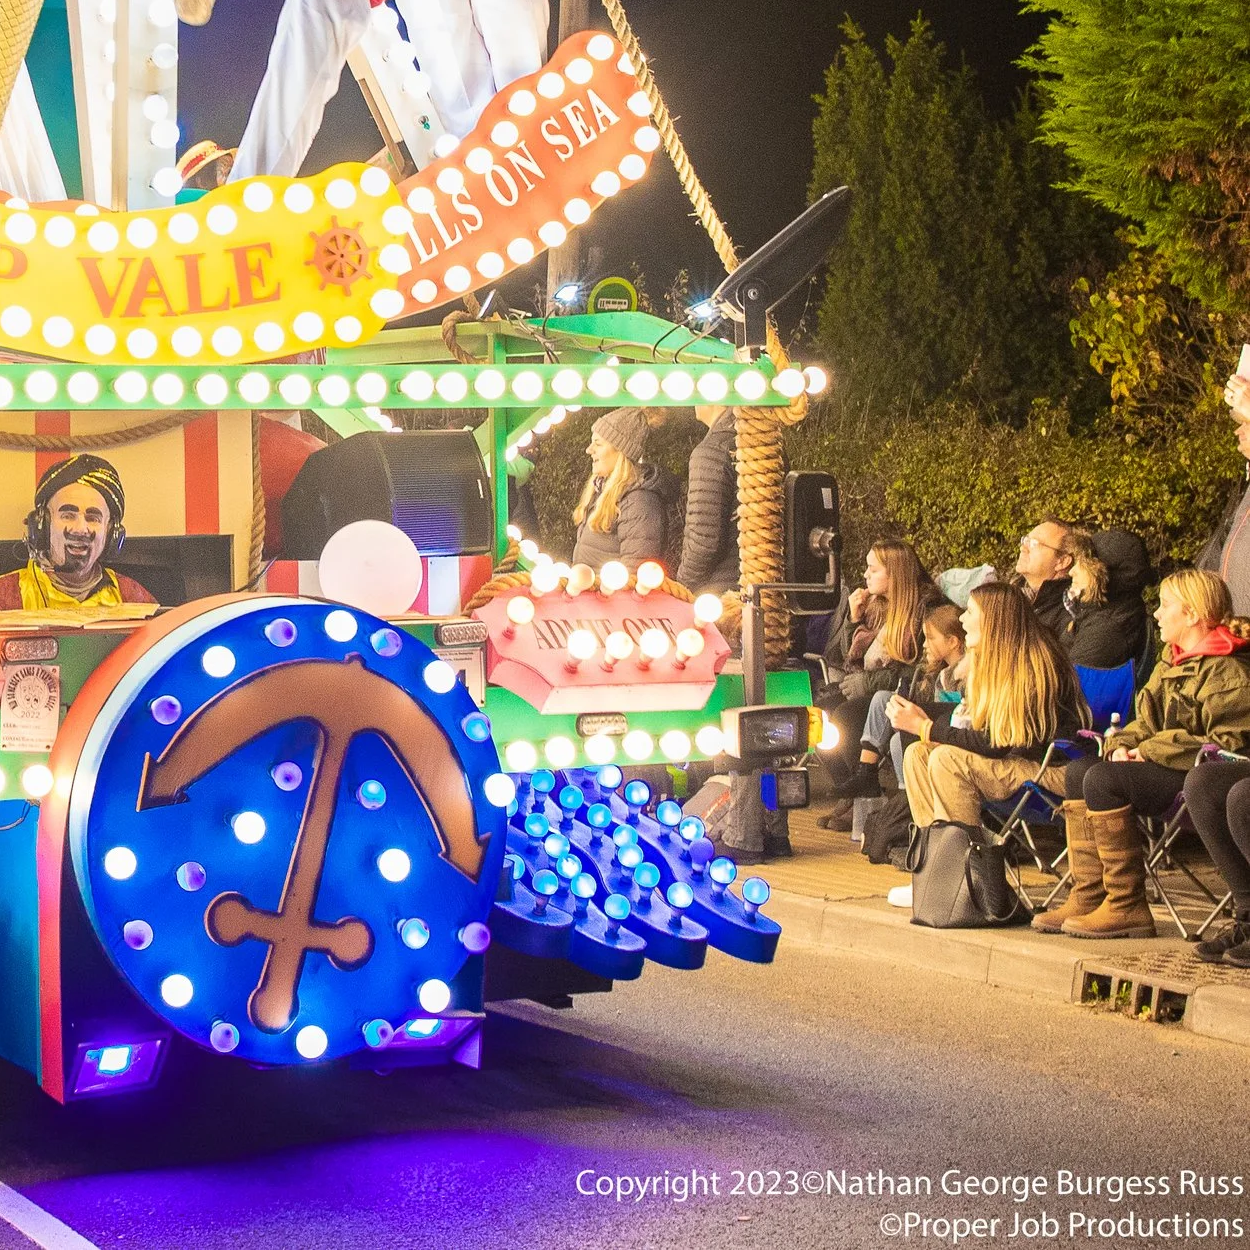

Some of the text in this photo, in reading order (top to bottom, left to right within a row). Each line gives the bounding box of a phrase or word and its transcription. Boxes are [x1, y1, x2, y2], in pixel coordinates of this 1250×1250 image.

[483, 139, 547, 208] ON
[539, 87, 622, 163] SEA
[77, 240, 282, 320] VALE
[20, 710, 41, 719] 2022
